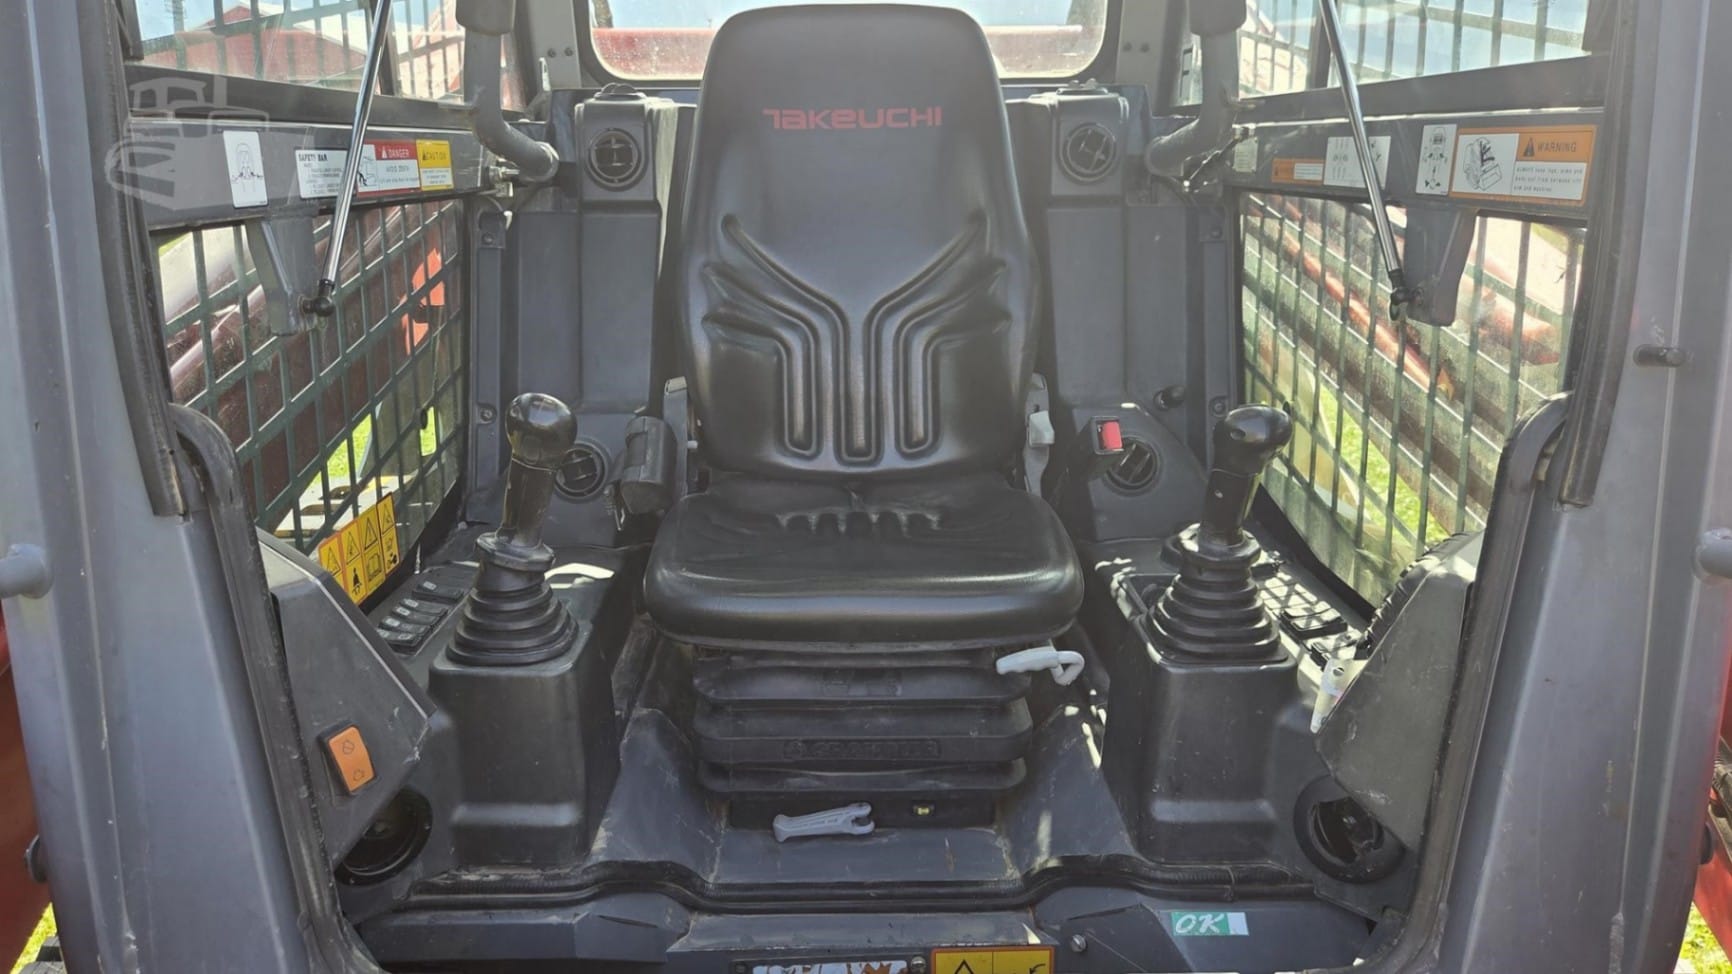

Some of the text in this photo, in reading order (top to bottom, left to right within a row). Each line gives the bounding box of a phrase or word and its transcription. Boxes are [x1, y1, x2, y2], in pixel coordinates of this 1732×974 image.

[1537, 141, 1577, 153] WARNING
[387, 148, 410, 159] DANGER
[1175, 913, 1225, 934] OK
